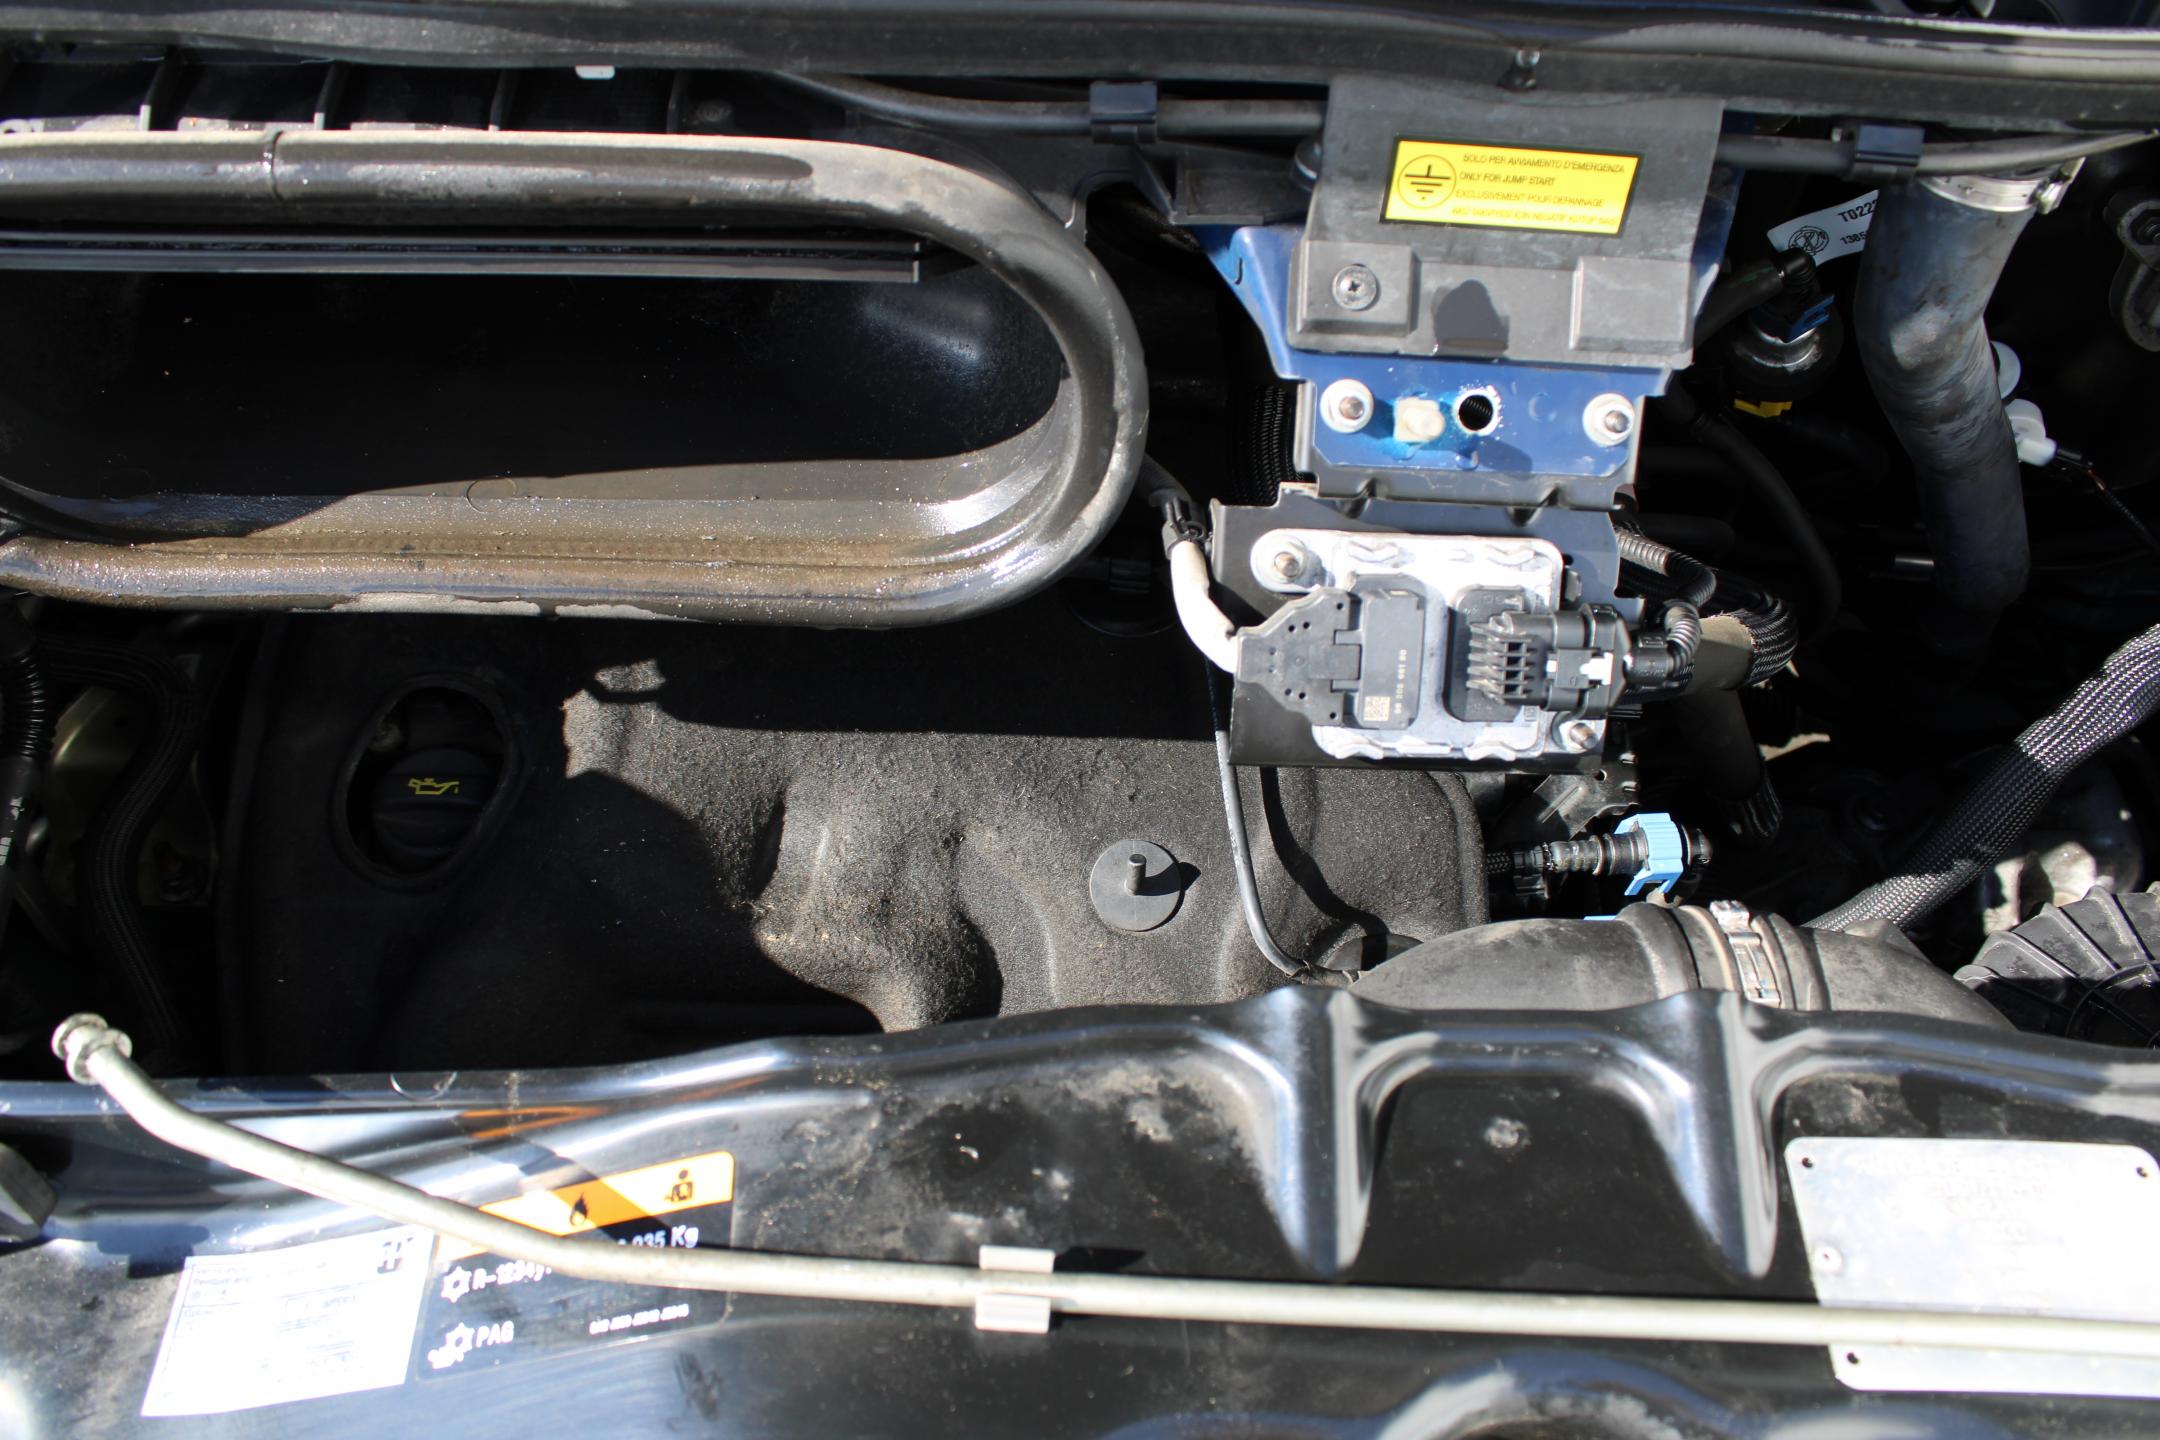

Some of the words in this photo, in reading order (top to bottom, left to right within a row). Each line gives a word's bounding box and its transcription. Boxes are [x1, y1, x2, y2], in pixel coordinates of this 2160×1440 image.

[1463, 153, 1487, 163] SOLO
[1489, 155, 1506, 165] PER
[1508, 156, 1562, 169] AVVIAMENTO
[1460, 171, 1481, 181] ONLY
[1483, 173, 1501, 182] FOR
[1503, 174, 1527, 184] JUMP
[1529, 175, 1556, 185] START
[1456, 189, 1525, 200] EXCLUSIVEMENT
[671, 1224, 699, 1248] Kg
[473, 1259, 552, 1289] R-1234y
[476, 1320, 514, 1348] PAG
